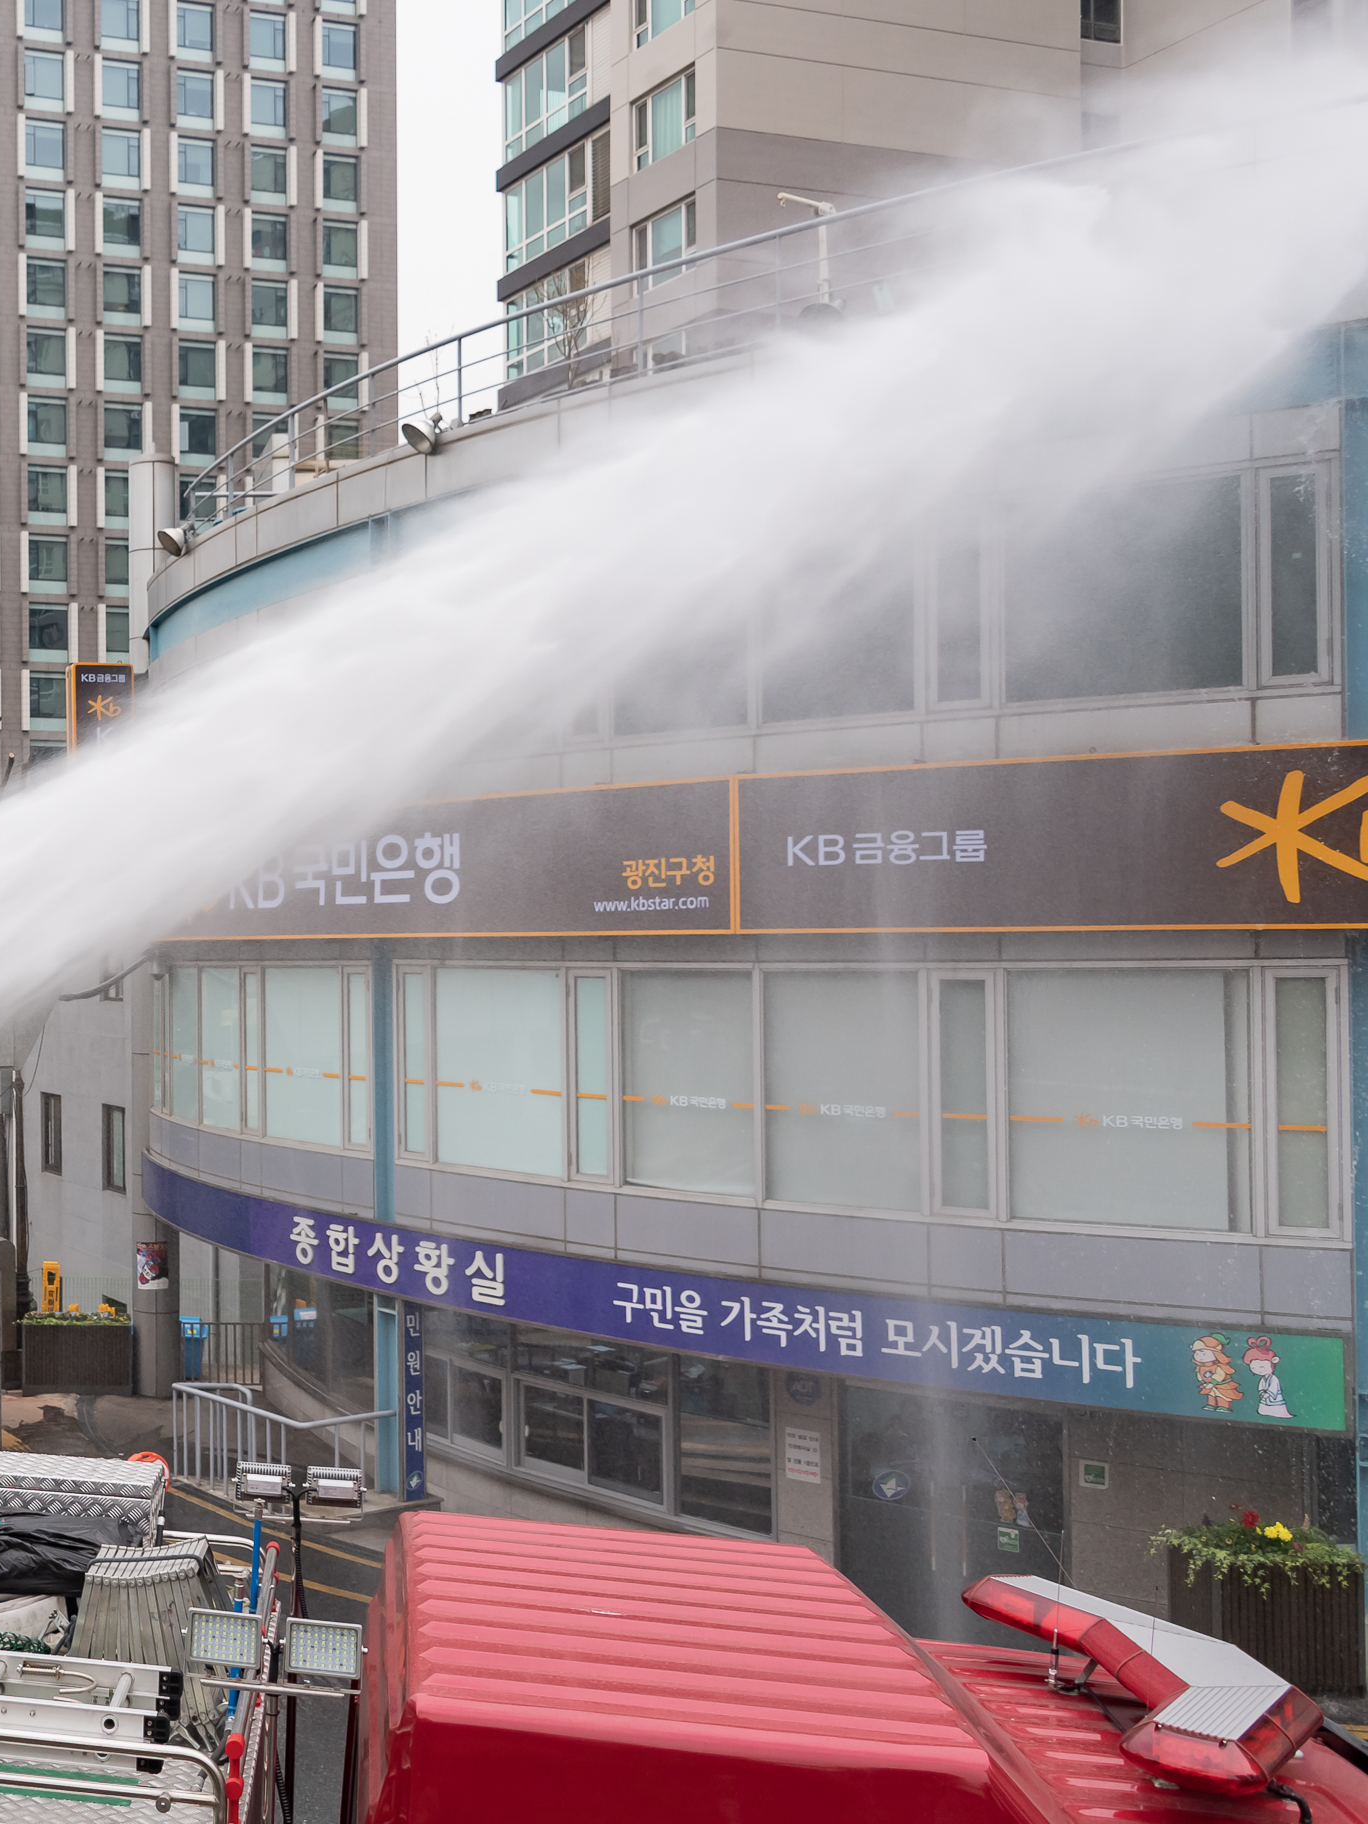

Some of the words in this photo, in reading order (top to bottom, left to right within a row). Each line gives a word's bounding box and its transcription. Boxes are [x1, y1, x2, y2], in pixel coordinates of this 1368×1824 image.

[621, 854, 716, 890] 광진구청
[787, 829, 988, 867] KB금융그룹
[593, 896, 710, 912] www.kbstar.com
[289, 1215, 506, 1307] 종합상황실
[612, 1282, 709, 1335] 구민을
[720, 1296, 864, 1357] 가족처럼
[881, 1319, 1142, 1389] 모시겠습니다
[405, 1311, 423, 1452] 민원안내
